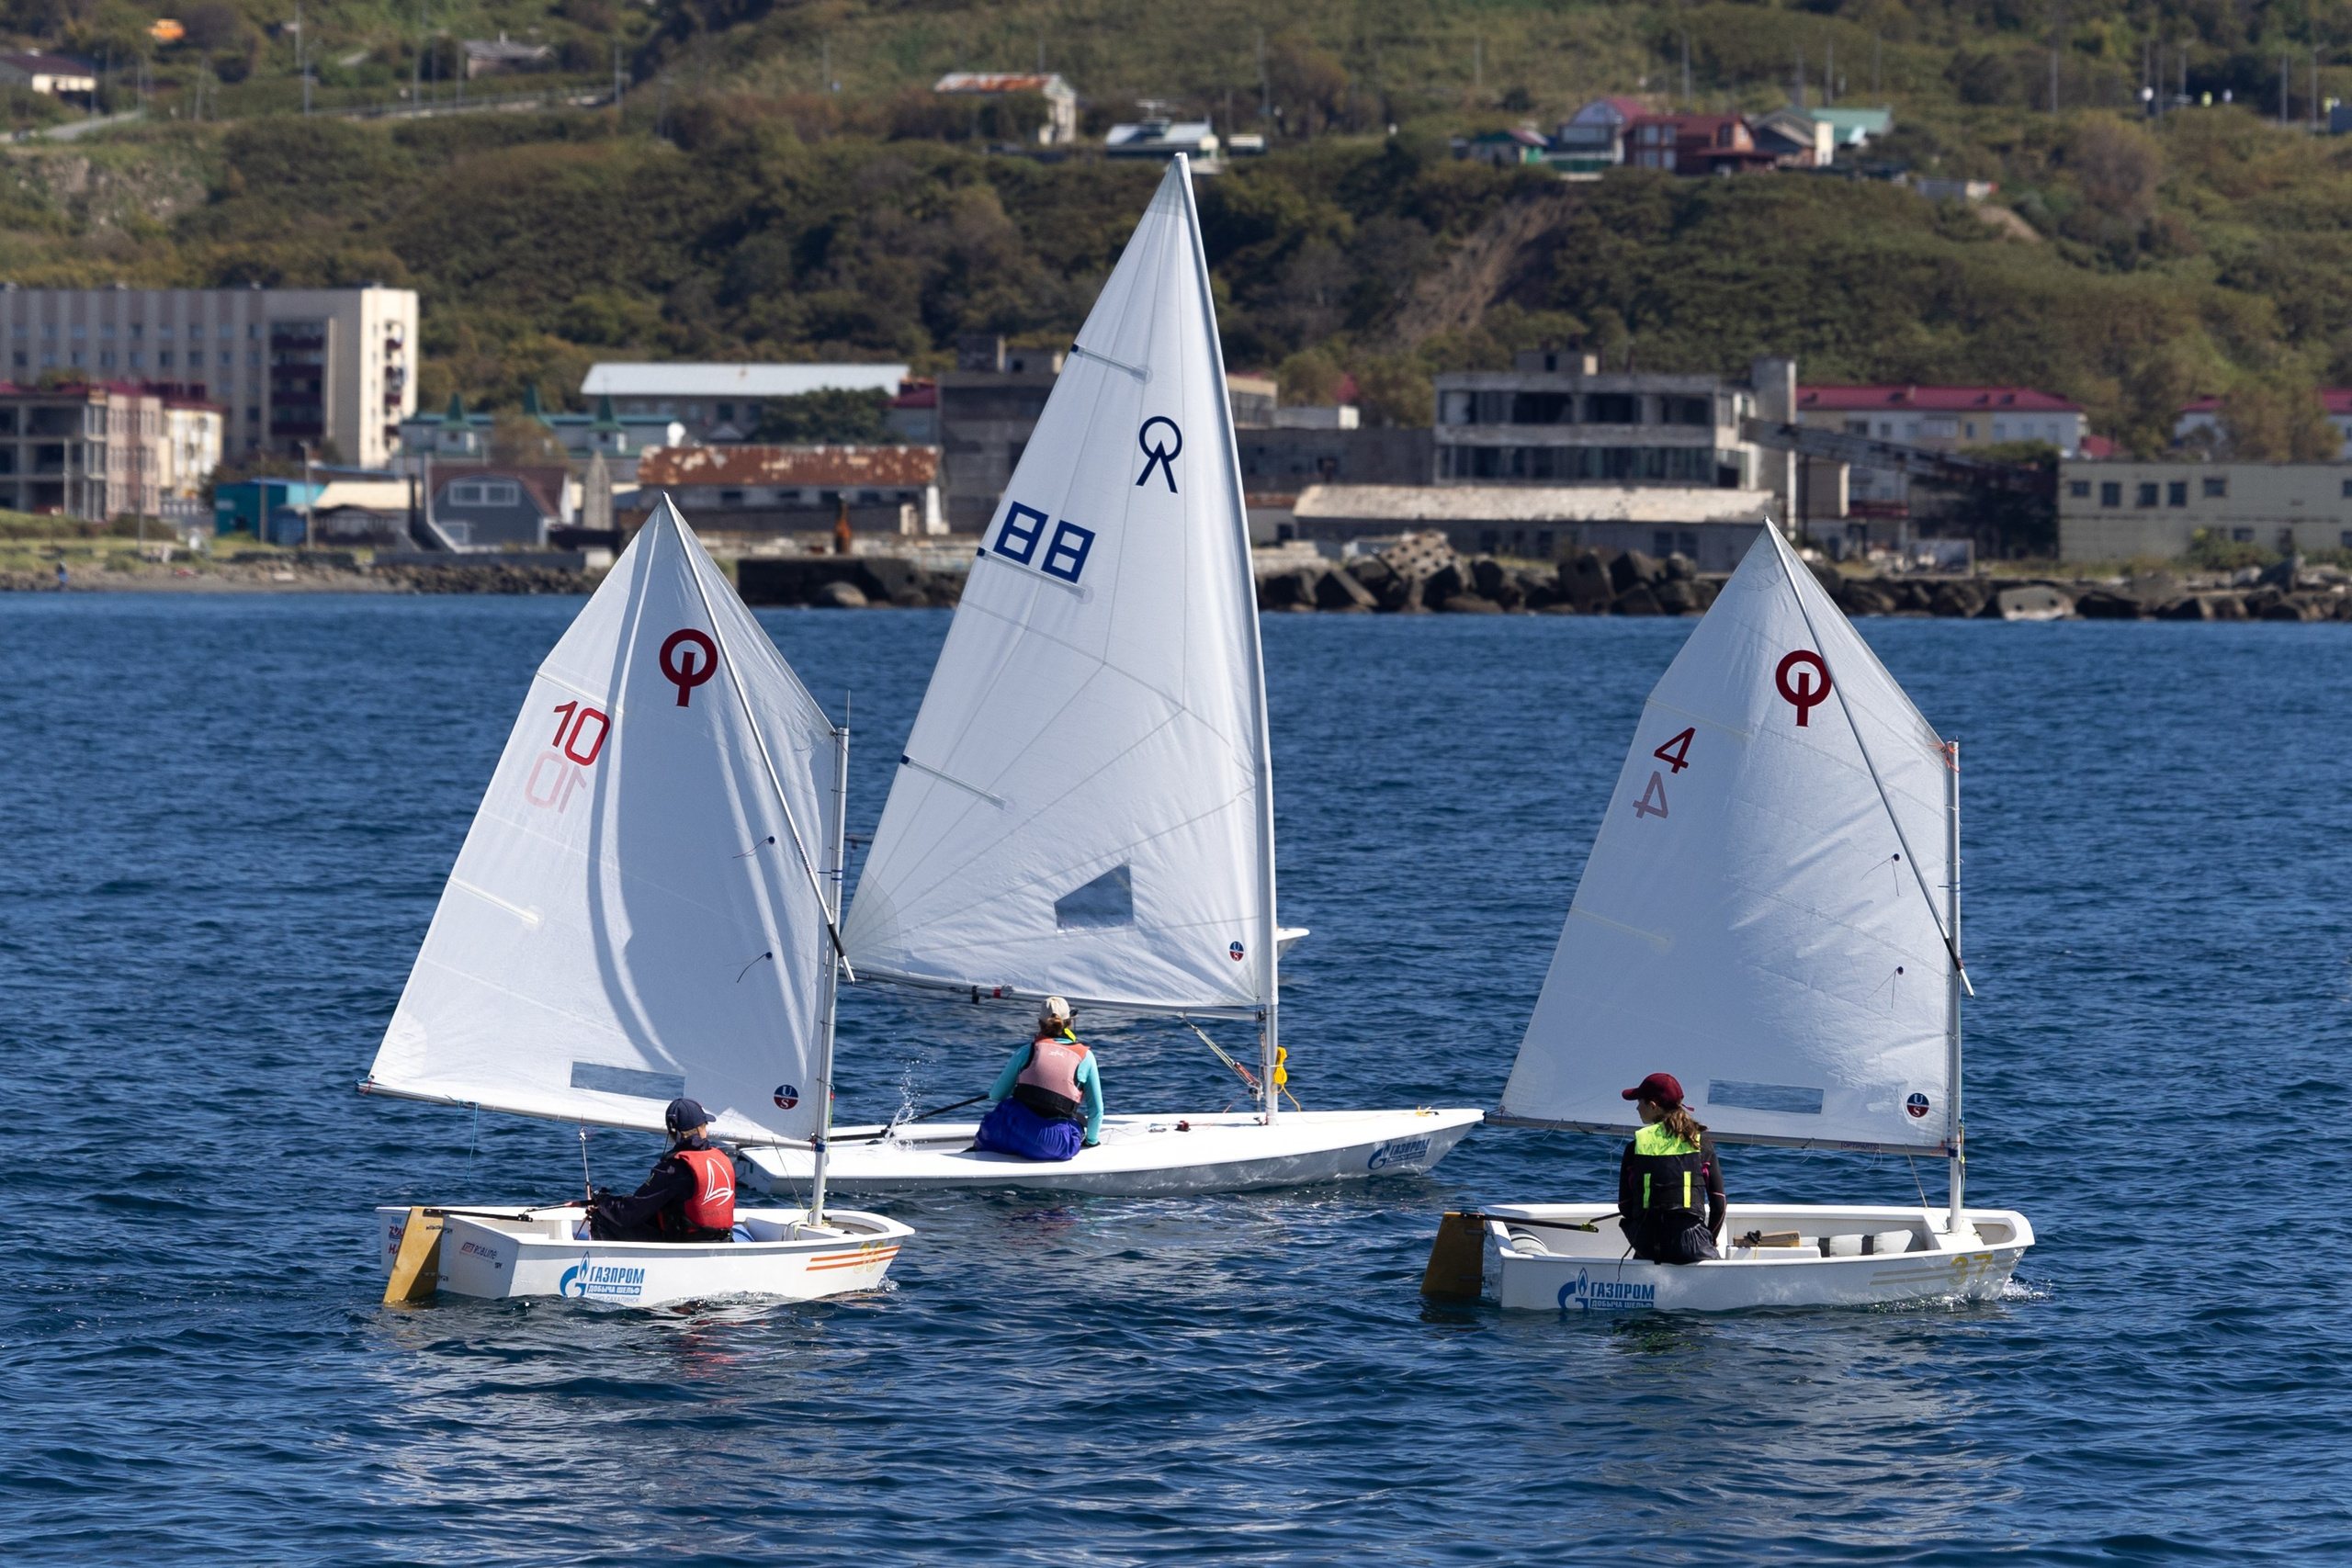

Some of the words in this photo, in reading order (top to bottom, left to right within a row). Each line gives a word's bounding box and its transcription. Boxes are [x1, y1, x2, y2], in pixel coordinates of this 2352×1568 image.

[993, 501, 1096, 583] 88
[552, 700, 611, 766] 10
[1654, 727, 1696, 773] 4
[1389, 1138, 1431, 1156] ГАЗПРОМ
[589, 1267, 645, 1284] ГАЗПРОМ
[1948, 1254, 1994, 1285] 37
[588, 1285, 616, 1293] ДОБЫЧА
[616, 1286, 640, 1294] ШЕЛЬФ
[1590, 1282, 1655, 1300] ГАЗПРОМ
[1591, 1300, 1623, 1308] ДОБЫЧА
